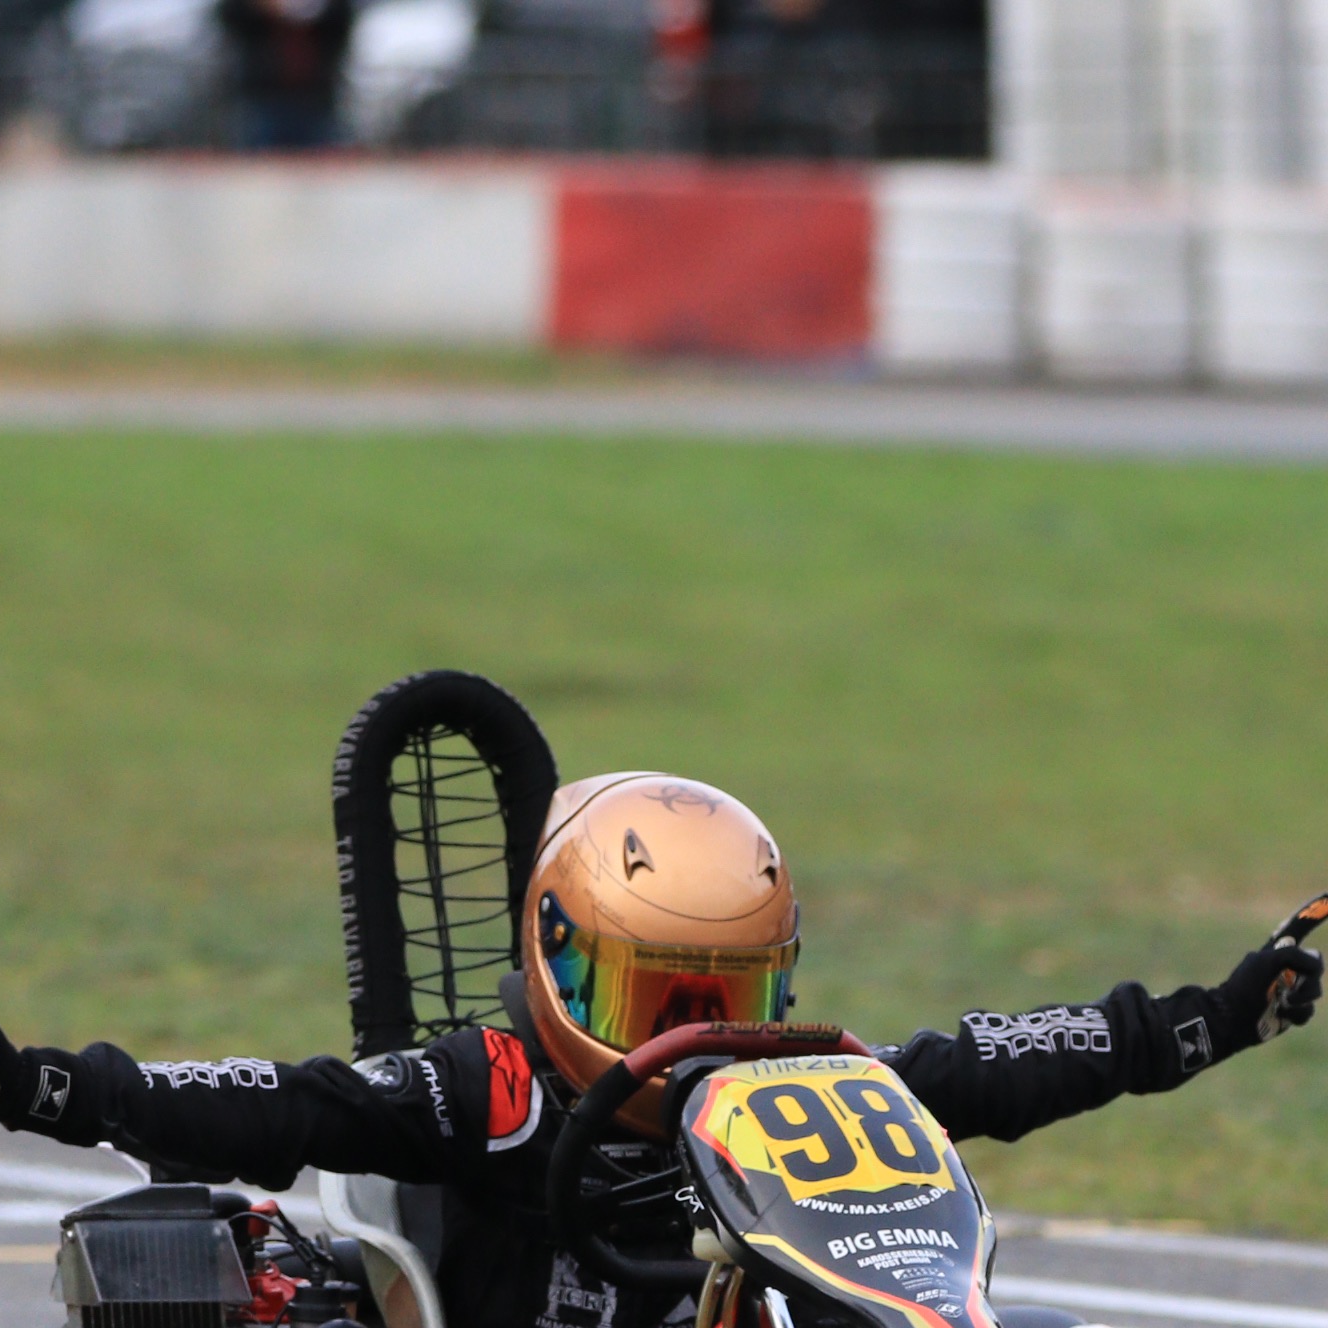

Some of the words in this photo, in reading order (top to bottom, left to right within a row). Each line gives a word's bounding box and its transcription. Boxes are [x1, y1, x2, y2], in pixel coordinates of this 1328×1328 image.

[746, 1078, 941, 1183] 98
[826, 1232, 876, 1260] BIG
[877, 1228, 959, 1250] EMMA
